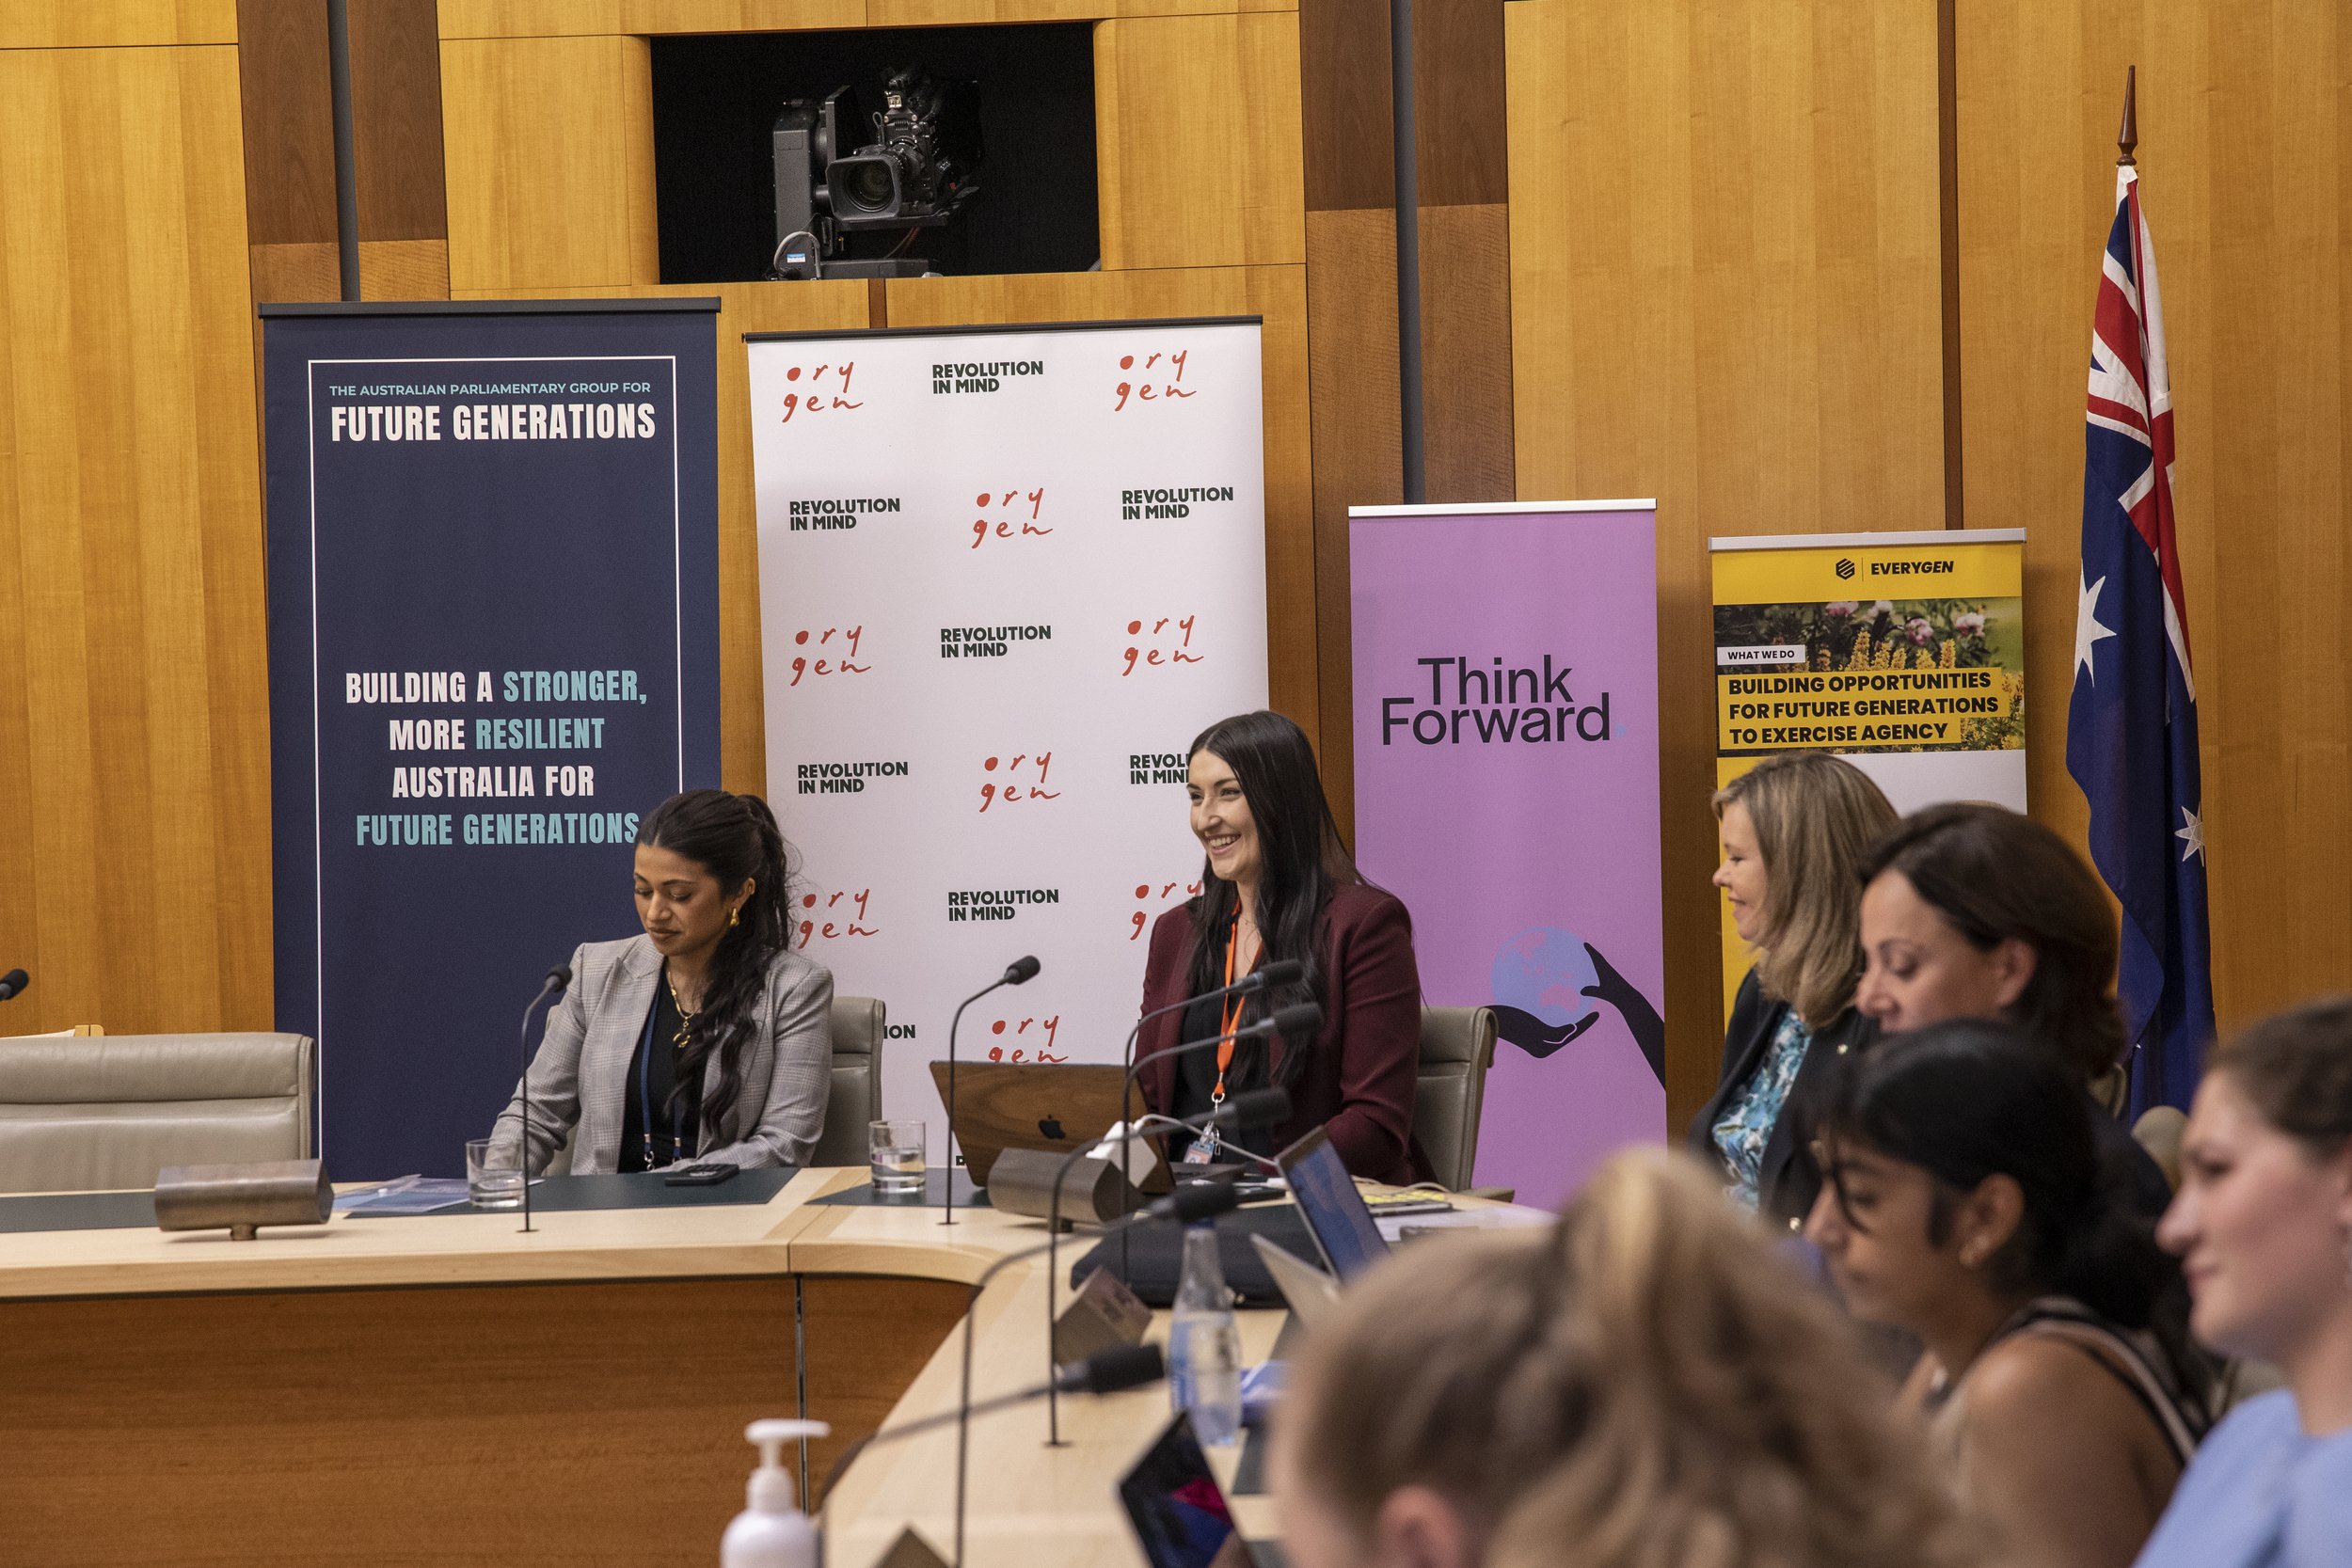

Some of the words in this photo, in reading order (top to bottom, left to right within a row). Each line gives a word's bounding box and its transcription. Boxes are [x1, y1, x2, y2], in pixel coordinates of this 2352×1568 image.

[931, 360, 1043, 379] REVOLUTION
[328, 385, 357, 396] THE
[359, 384, 446, 396] AUSTRALIAN
[450, 383, 567, 395] PARLIAMENTARY
[569, 382, 619, 394] GROUP
[623, 382, 651, 393] FOR
[932, 379, 951, 395] IN
[955, 377, 1000, 394] MIND
[1115, 381, 1197, 412] gen
[783, 392, 864, 422] gen
[331, 405, 441, 442] FUTURE
[453, 403, 656, 441] GENERATIONS
[1121, 486, 1234, 505] REVOLUTION
[789, 498, 900, 516] REVOLUTION
[1122, 505, 1141, 520] IN
[1144, 503, 1190, 520] MIND
[789, 515, 808, 531] IN
[812, 515, 857, 531] MIND
[971, 518, 1052, 550] gen
[1870, 560, 1955, 576] EVERYGEN
[940, 625, 1052, 643] REVOLUTION
[941, 643, 960, 658] IN
[962, 641, 1009, 657] MIND
[1727, 651, 1760, 660] WHAT
[1761, 650, 1778, 659] WE
[1779, 649, 1795, 658] DO
[790, 657, 872, 687] gen
[1122, 646, 1202, 677] gen
[345, 671, 466, 704] BUILDING
[476, 671, 494, 703] A
[503, 670, 647, 705] STRONGER,
[1417, 654, 1575, 705] Think
[1728, 675, 1825, 695] BUILDING
[1828, 672, 1992, 692] OPPORTUNITIES
[1382, 691, 1611, 746] Forward
[1729, 703, 1771, 721] FOR
[1773, 700, 1851, 719] FUTURE
[1853, 696, 1999, 717] GENERATIONS
[389, 719, 466, 751] MORE
[475, 718, 605, 750] RESILIENT
[1728, 728, 1758, 745] TO
[1761, 725, 1857, 744] EXERCISE
[1860, 722, 1948, 741] AGENCY
[797, 761, 909, 779] REVOLUTION
[1129, 753, 1189, 769] REVOL
[392, 766, 535, 799] AUSTRALIA
[545, 765, 595, 797] FOR
[798, 779, 816, 795] IN
[819, 777, 865, 794] MIND
[1130, 769, 1149, 785] IN
[979, 782, 1060, 814] gen
[357, 814, 453, 846] FUTURE
[463, 812, 640, 845] GENERATIONS
[947, 889, 1059, 907] REVOLUTION
[948, 907, 967, 922] IN
[971, 905, 1016, 921] MIND
[799, 919, 879, 949] gen
